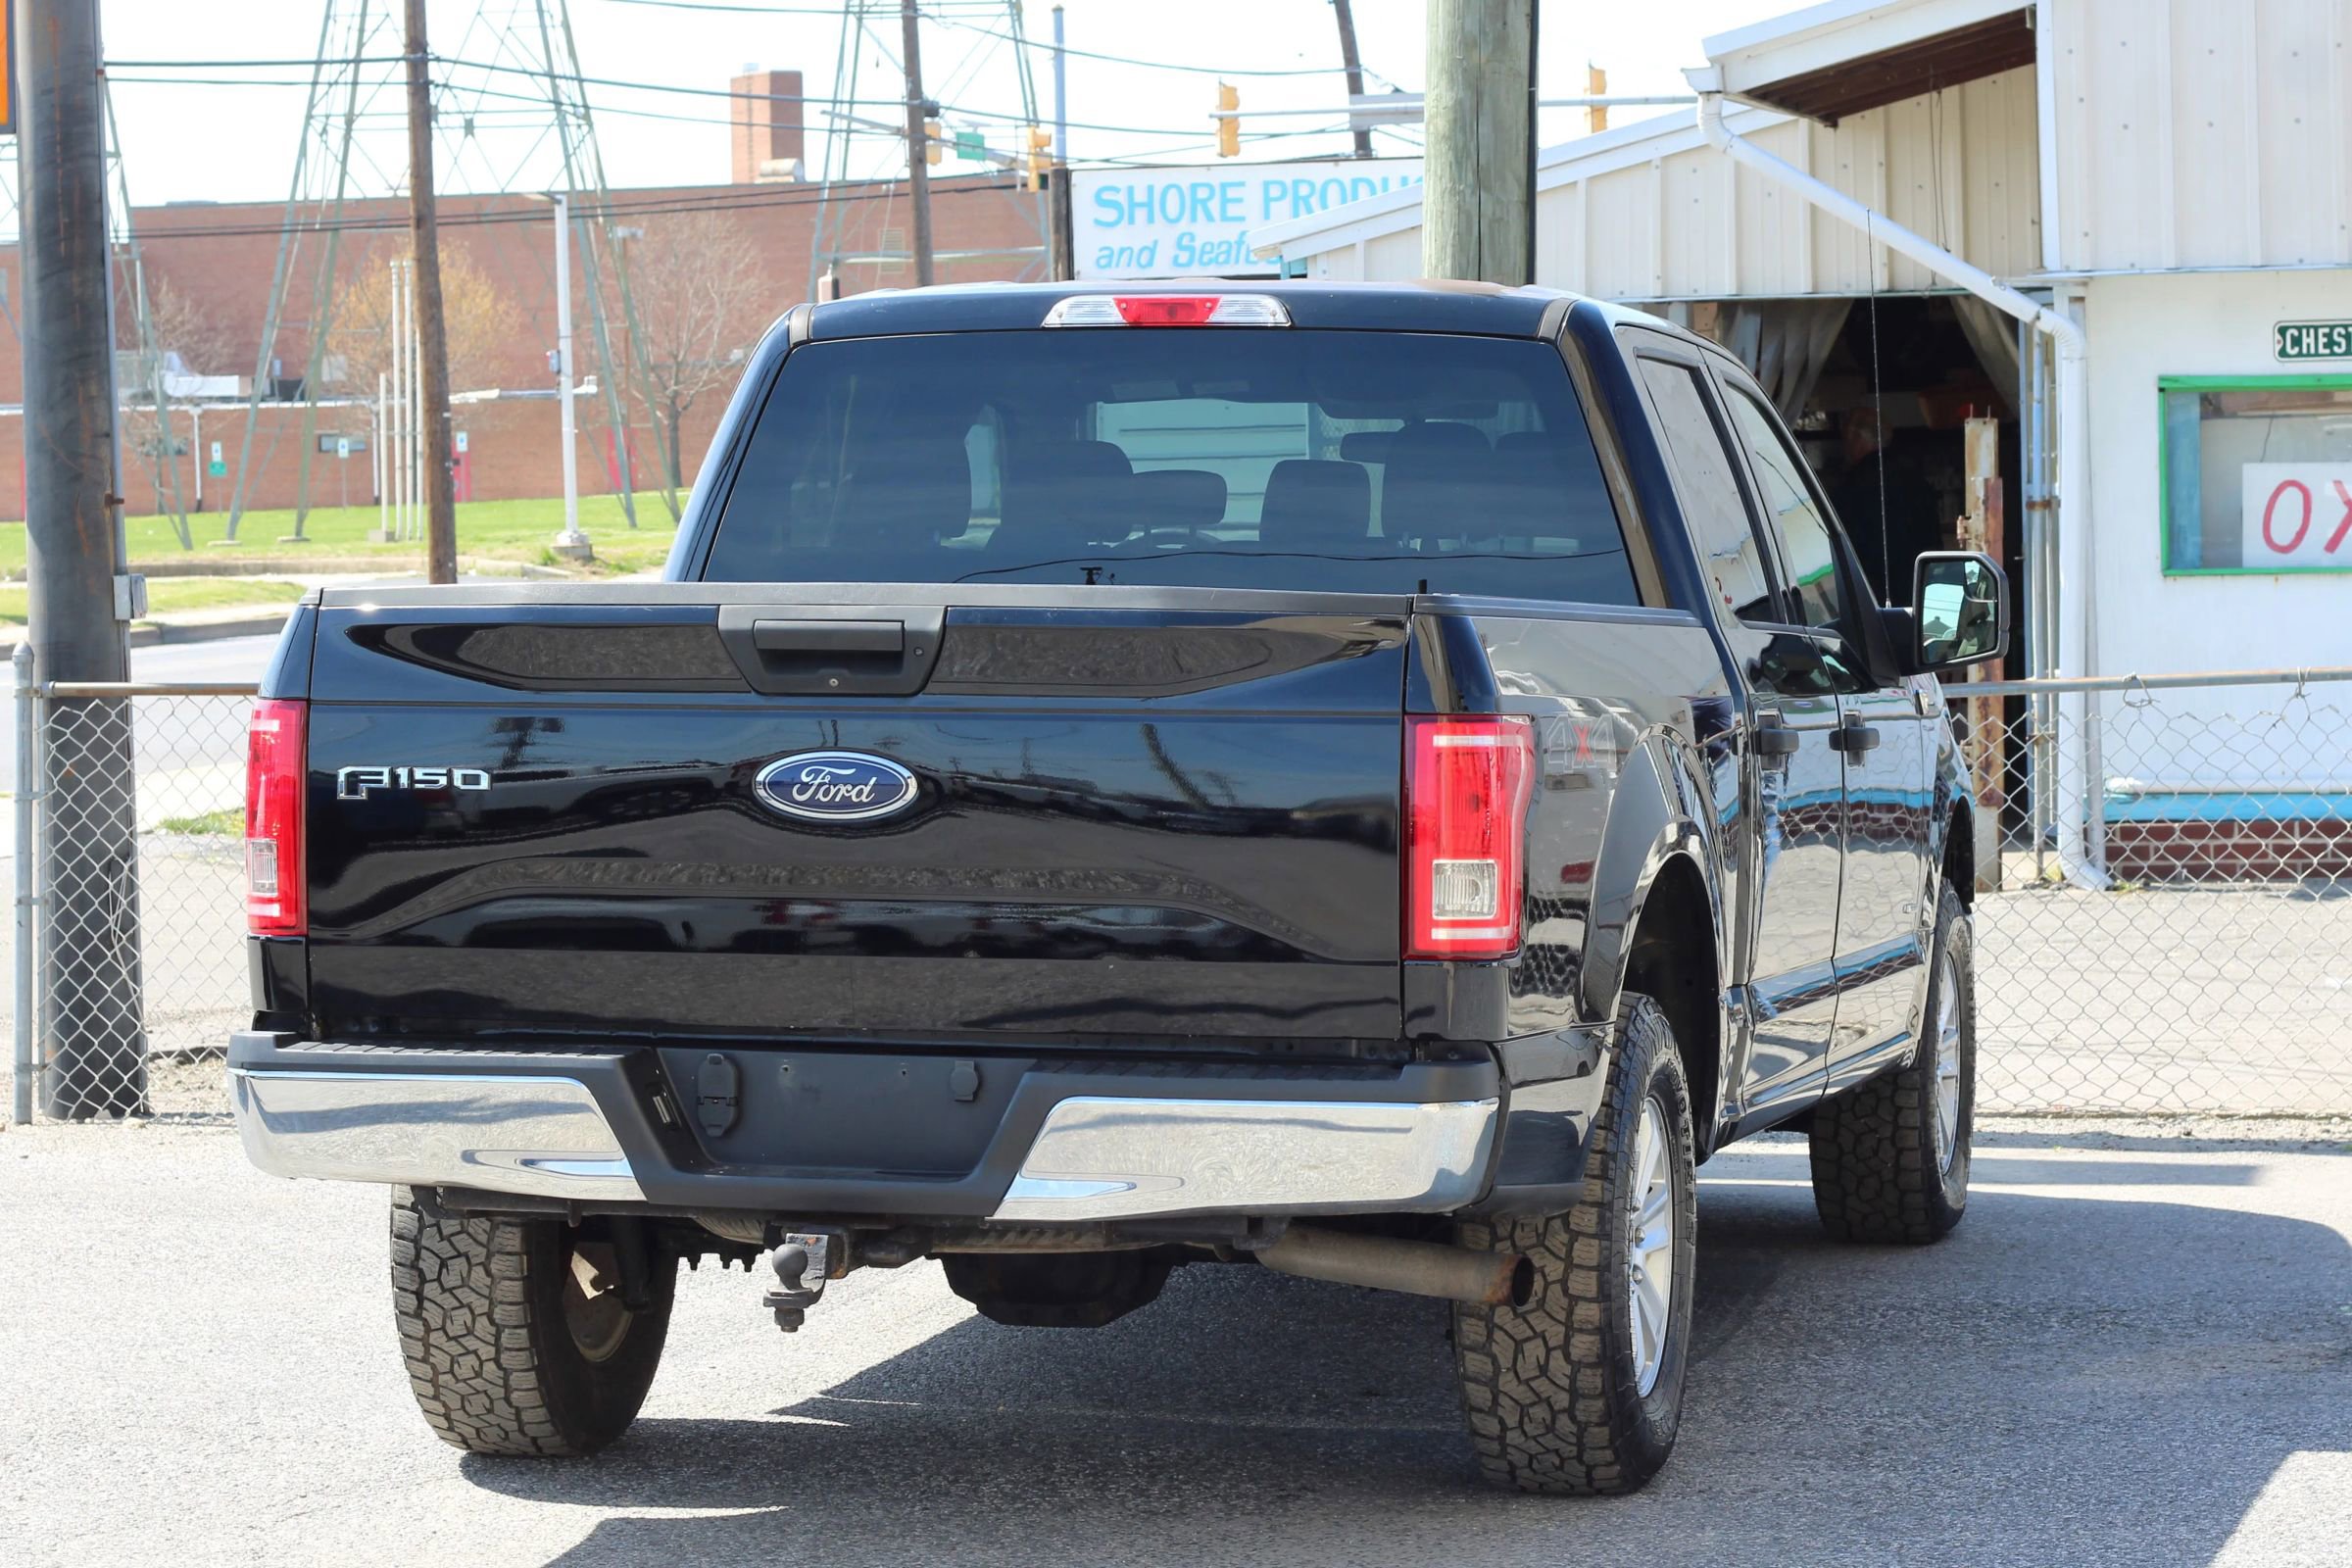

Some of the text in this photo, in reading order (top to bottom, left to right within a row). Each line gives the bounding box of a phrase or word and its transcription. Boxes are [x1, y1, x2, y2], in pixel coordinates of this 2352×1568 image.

[1093, 175, 1423, 228] SHORE PROD
[1096, 231, 1281, 270] and Seaf
[792, 765, 877, 803] Ford
[1680, 1119, 1695, 1247] TIRES
